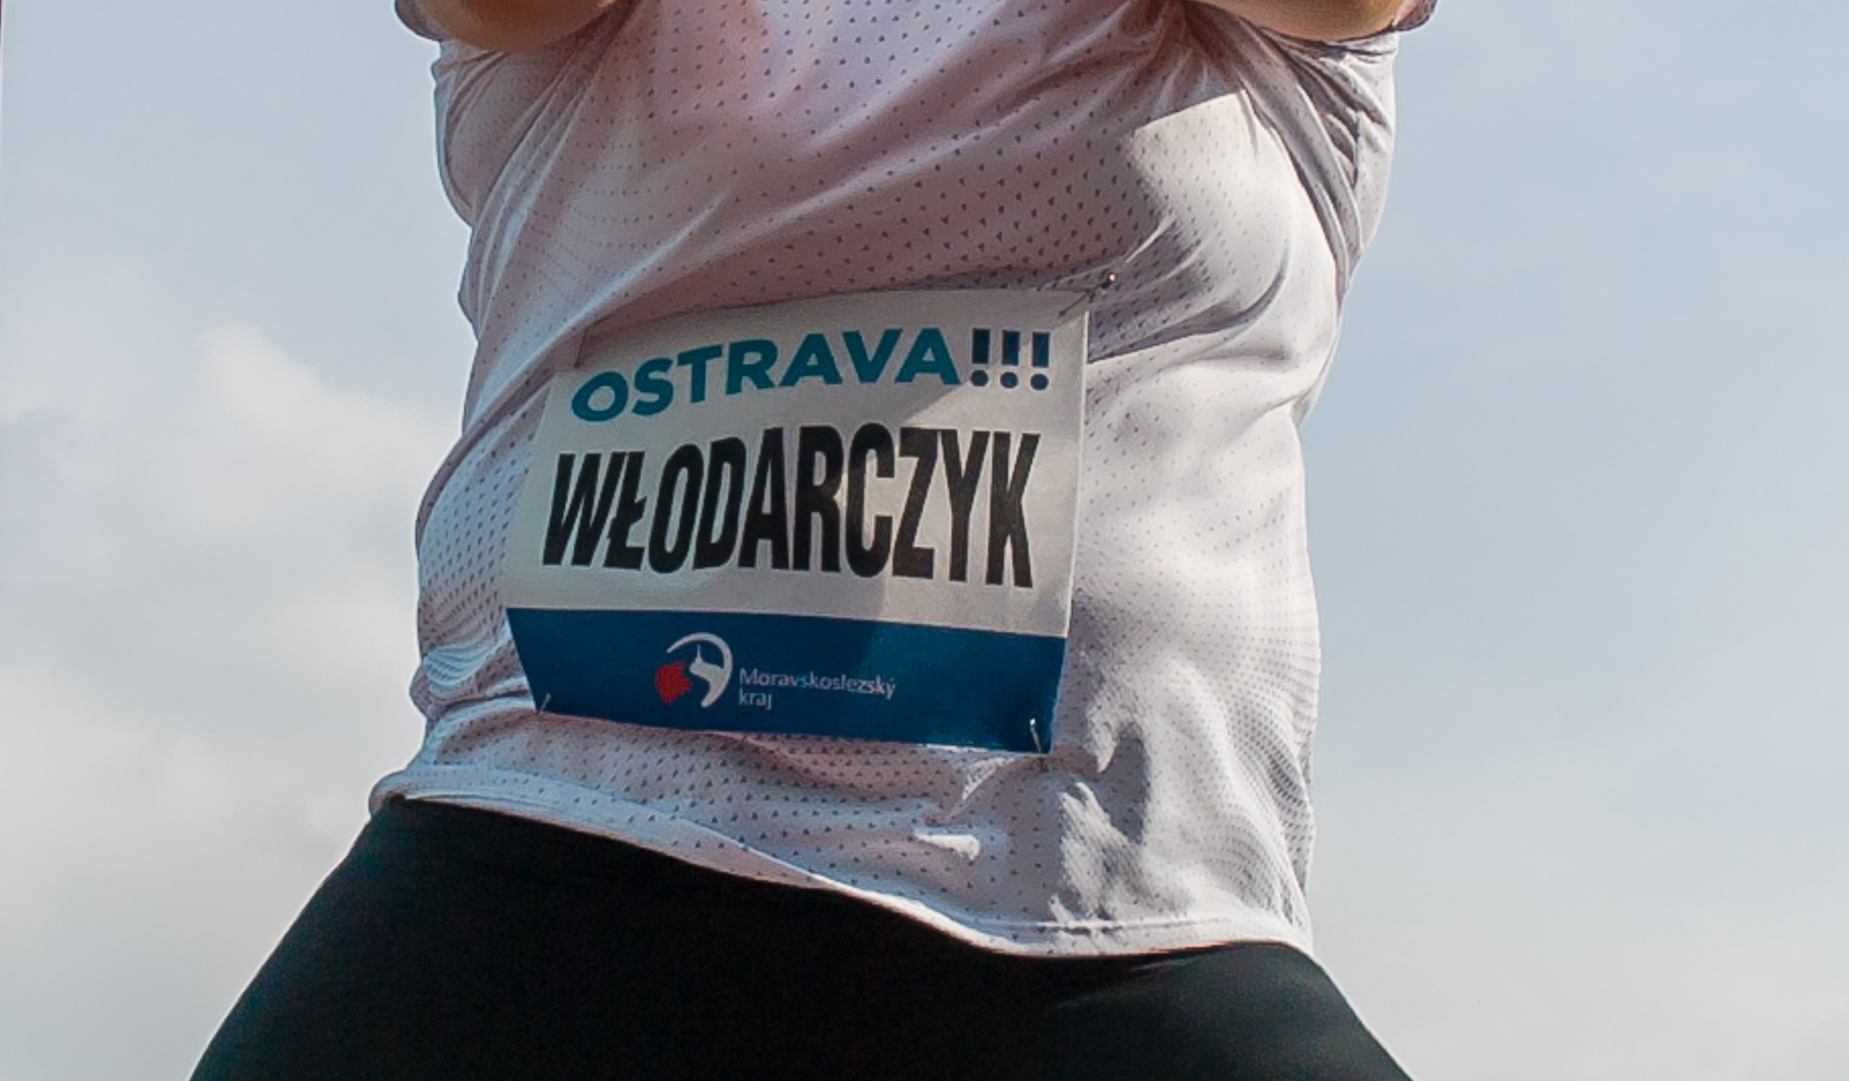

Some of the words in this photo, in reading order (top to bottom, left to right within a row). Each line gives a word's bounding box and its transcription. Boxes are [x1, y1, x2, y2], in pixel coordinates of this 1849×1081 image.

[571, 327, 1051, 422] OSTRAVA!!!
[542, 423, 1040, 589] WŁODARCZYK
[739, 668, 896, 700] Moravskoslezský
[739, 688, 773, 710] kraj
